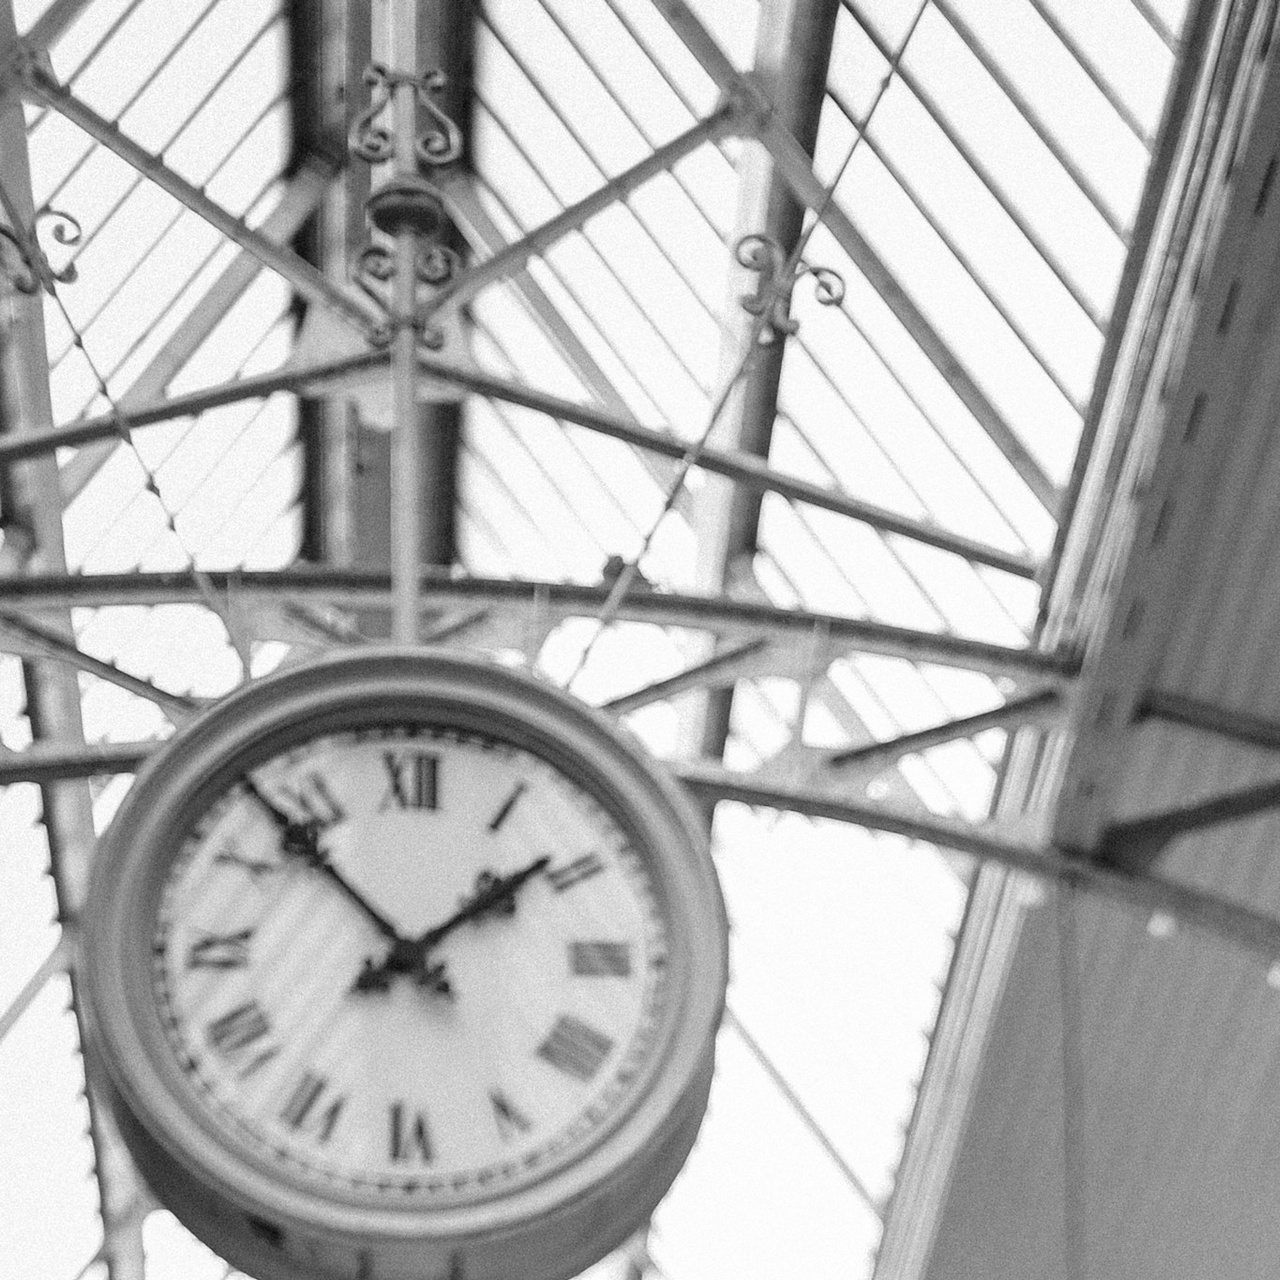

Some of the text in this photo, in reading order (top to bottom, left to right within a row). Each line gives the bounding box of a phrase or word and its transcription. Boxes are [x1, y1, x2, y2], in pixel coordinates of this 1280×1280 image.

[378, 751, 440, 812] XII
[489, 781, 528, 829] I
[389, 1101, 435, 1164] VI
